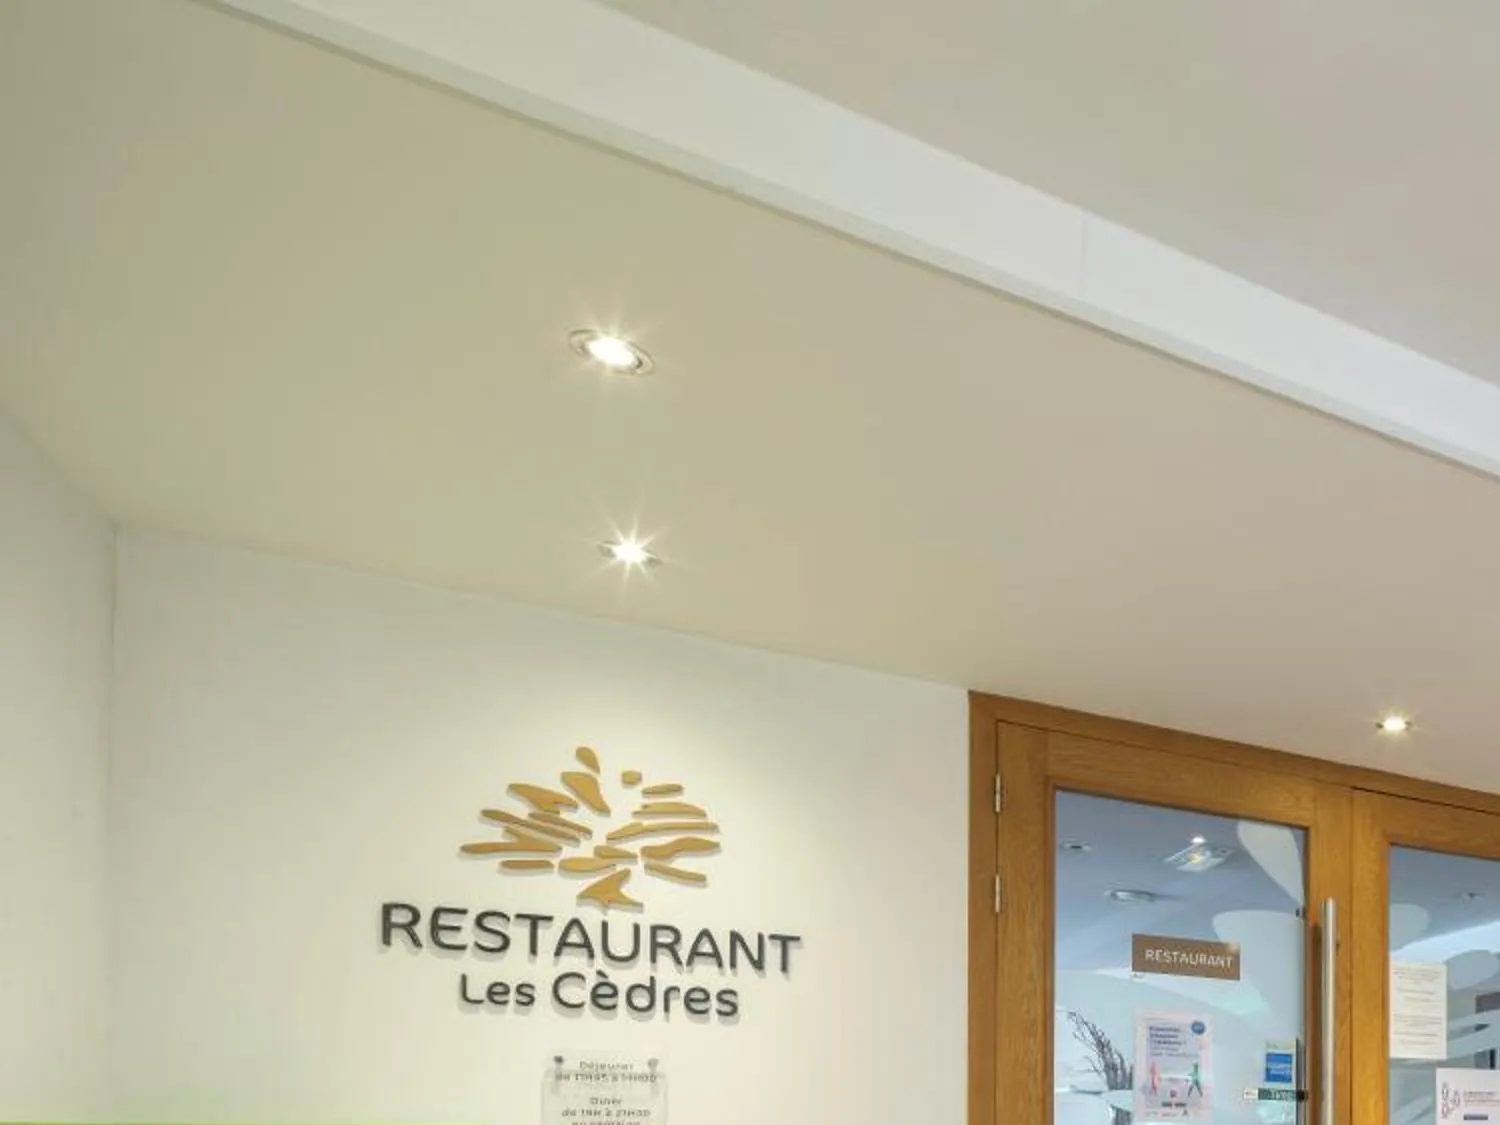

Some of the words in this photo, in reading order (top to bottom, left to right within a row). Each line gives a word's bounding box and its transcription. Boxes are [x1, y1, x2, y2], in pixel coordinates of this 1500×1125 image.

[380, 902, 801, 973] RESTAURANT
[1145, 948, 1233, 969] RESTAURANT
[458, 972, 536, 1007] Les
[551, 969, 739, 1018] Cèdres
[561, 1108, 577, 1117] de
